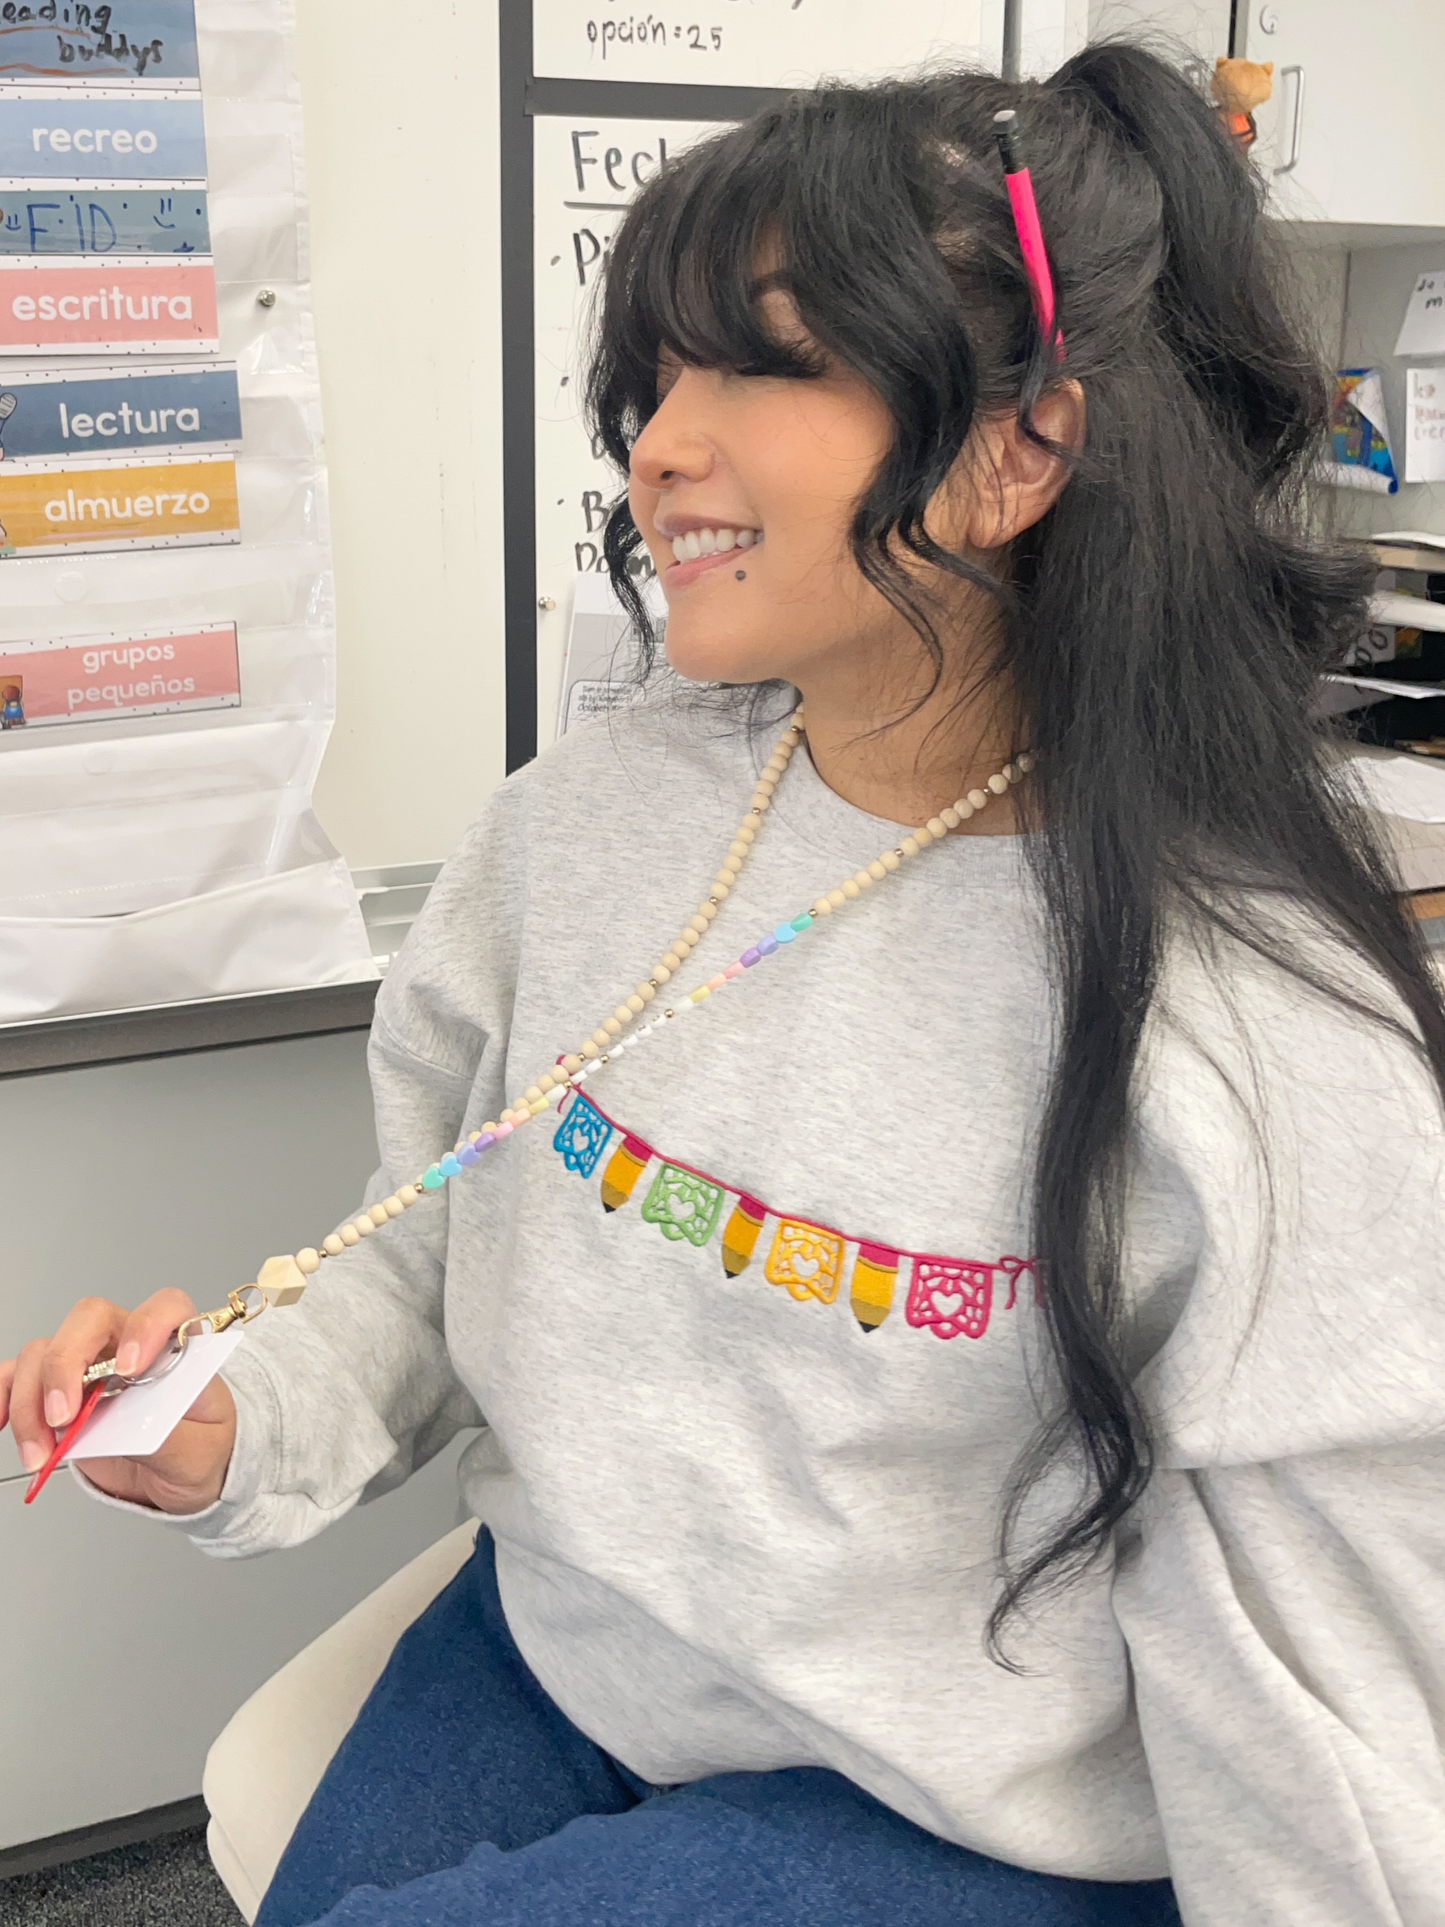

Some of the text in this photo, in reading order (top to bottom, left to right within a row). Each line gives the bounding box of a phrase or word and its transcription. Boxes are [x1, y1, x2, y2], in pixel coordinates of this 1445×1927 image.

[0, 0, 112, 35] eading
[56, 33, 164, 76] buddys
[32, 127, 158, 154] recreo
[12, 286, 192, 320] escritura
[59, 402, 201, 439] lectura
[44, 489, 210, 523] almuerzo
[82, 641, 175, 674] grupos
[67, 674, 196, 709] pequeños
